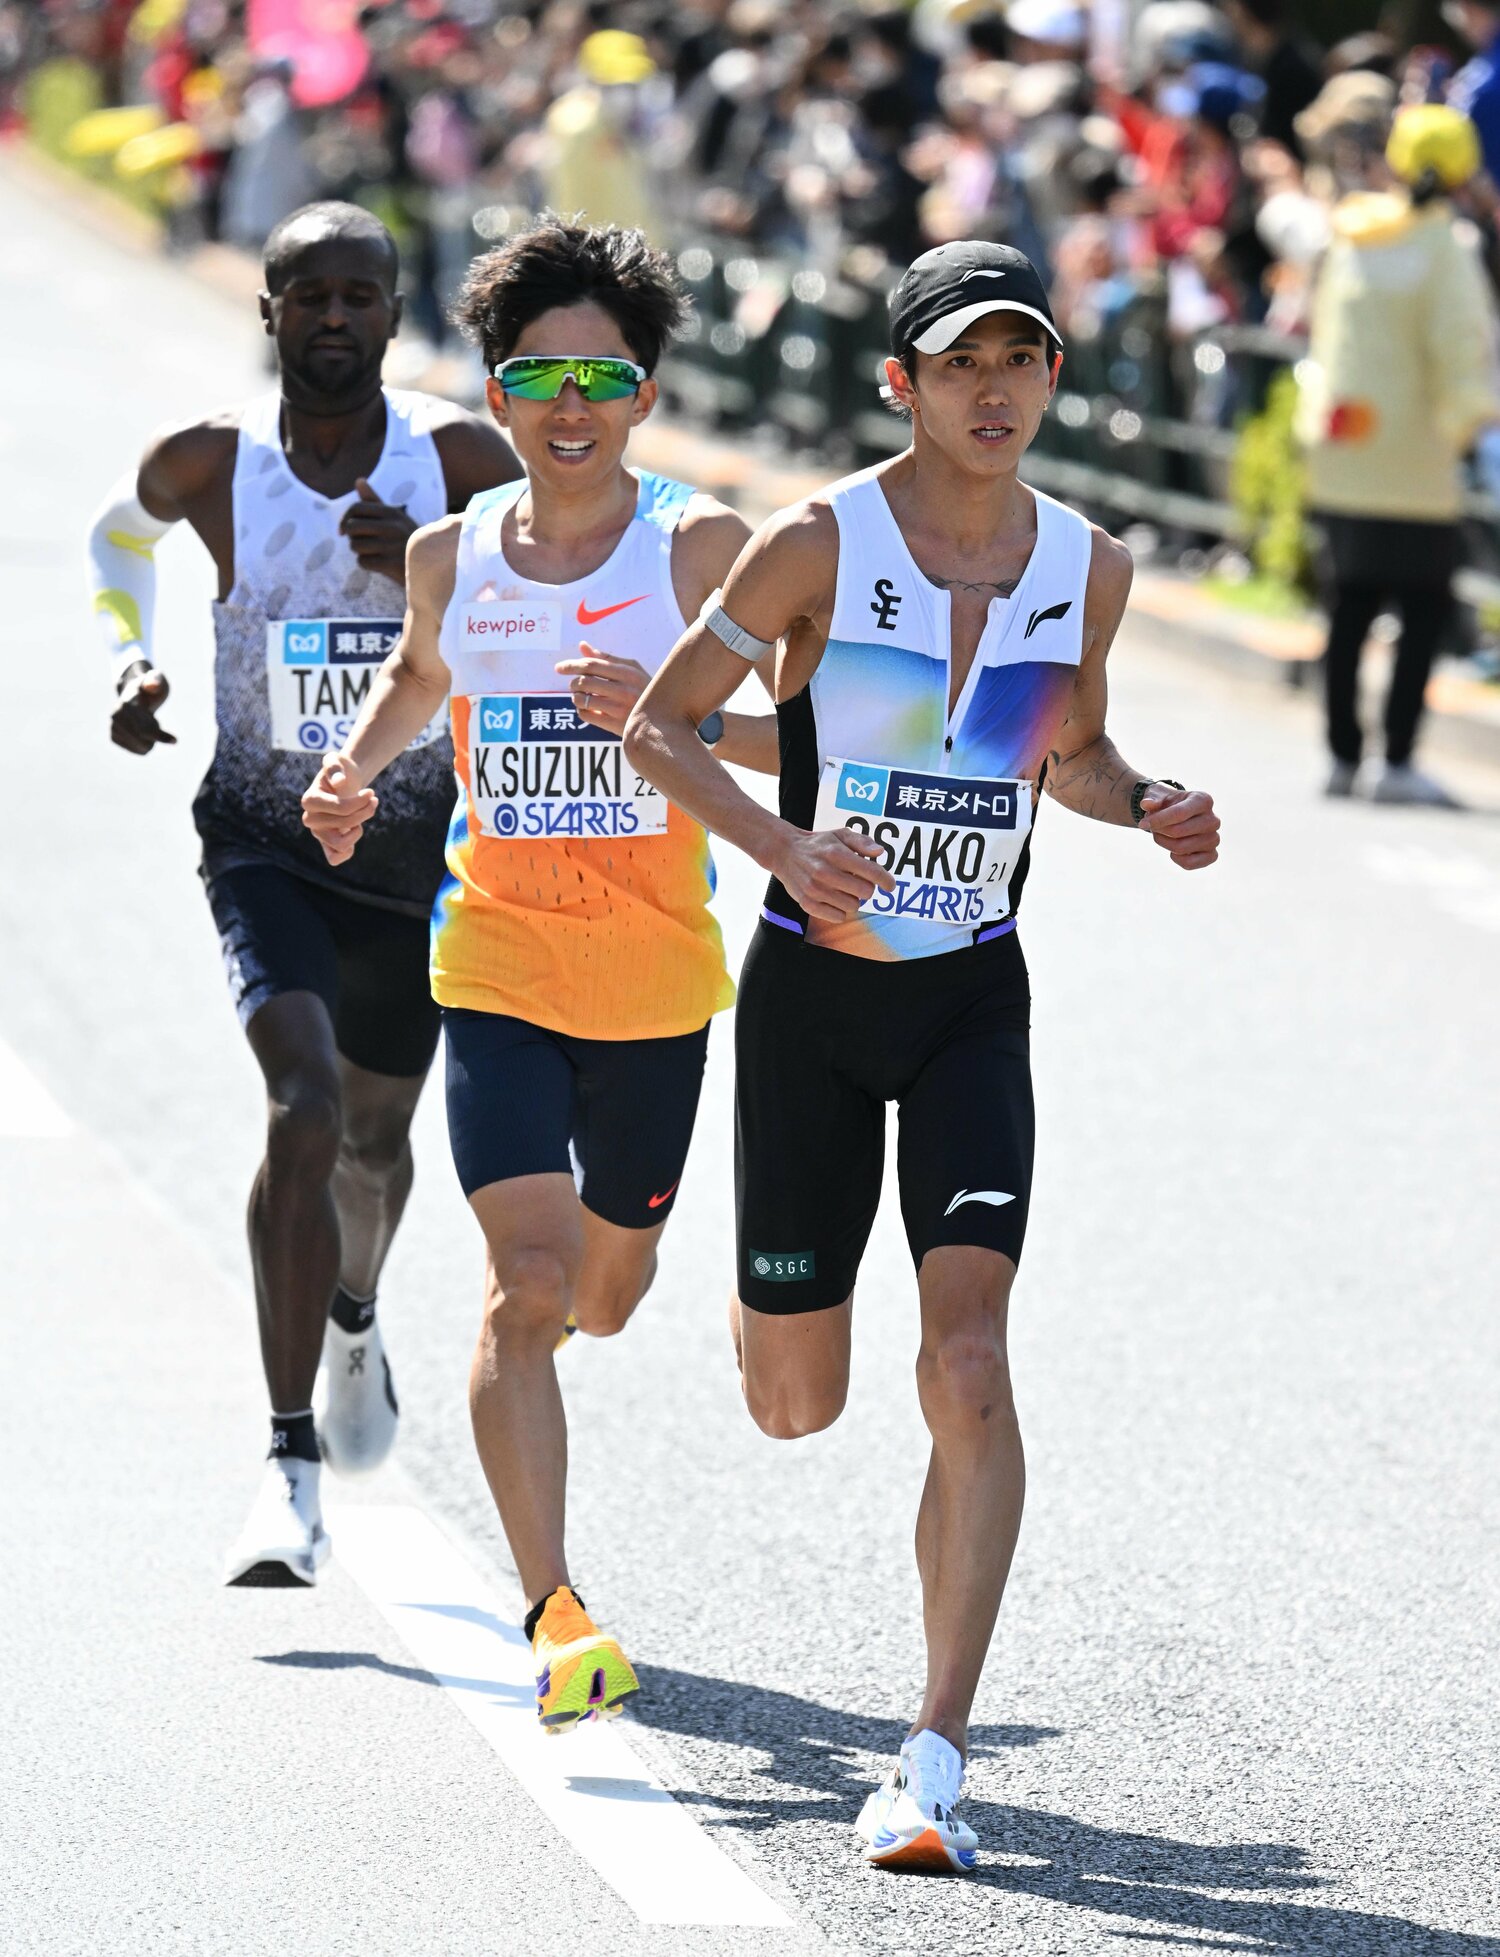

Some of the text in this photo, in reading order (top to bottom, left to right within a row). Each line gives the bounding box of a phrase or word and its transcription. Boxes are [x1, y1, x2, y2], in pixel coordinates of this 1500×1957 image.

[467, 613, 536, 638] kewpie
[292, 668, 380, 716] TAM
[475, 746, 621, 798] K.SUZUKI
[896, 785, 1010, 816] 東京メトロ
[986, 862, 1007, 882] 21
[775, 1260, 807, 1275] SGC
